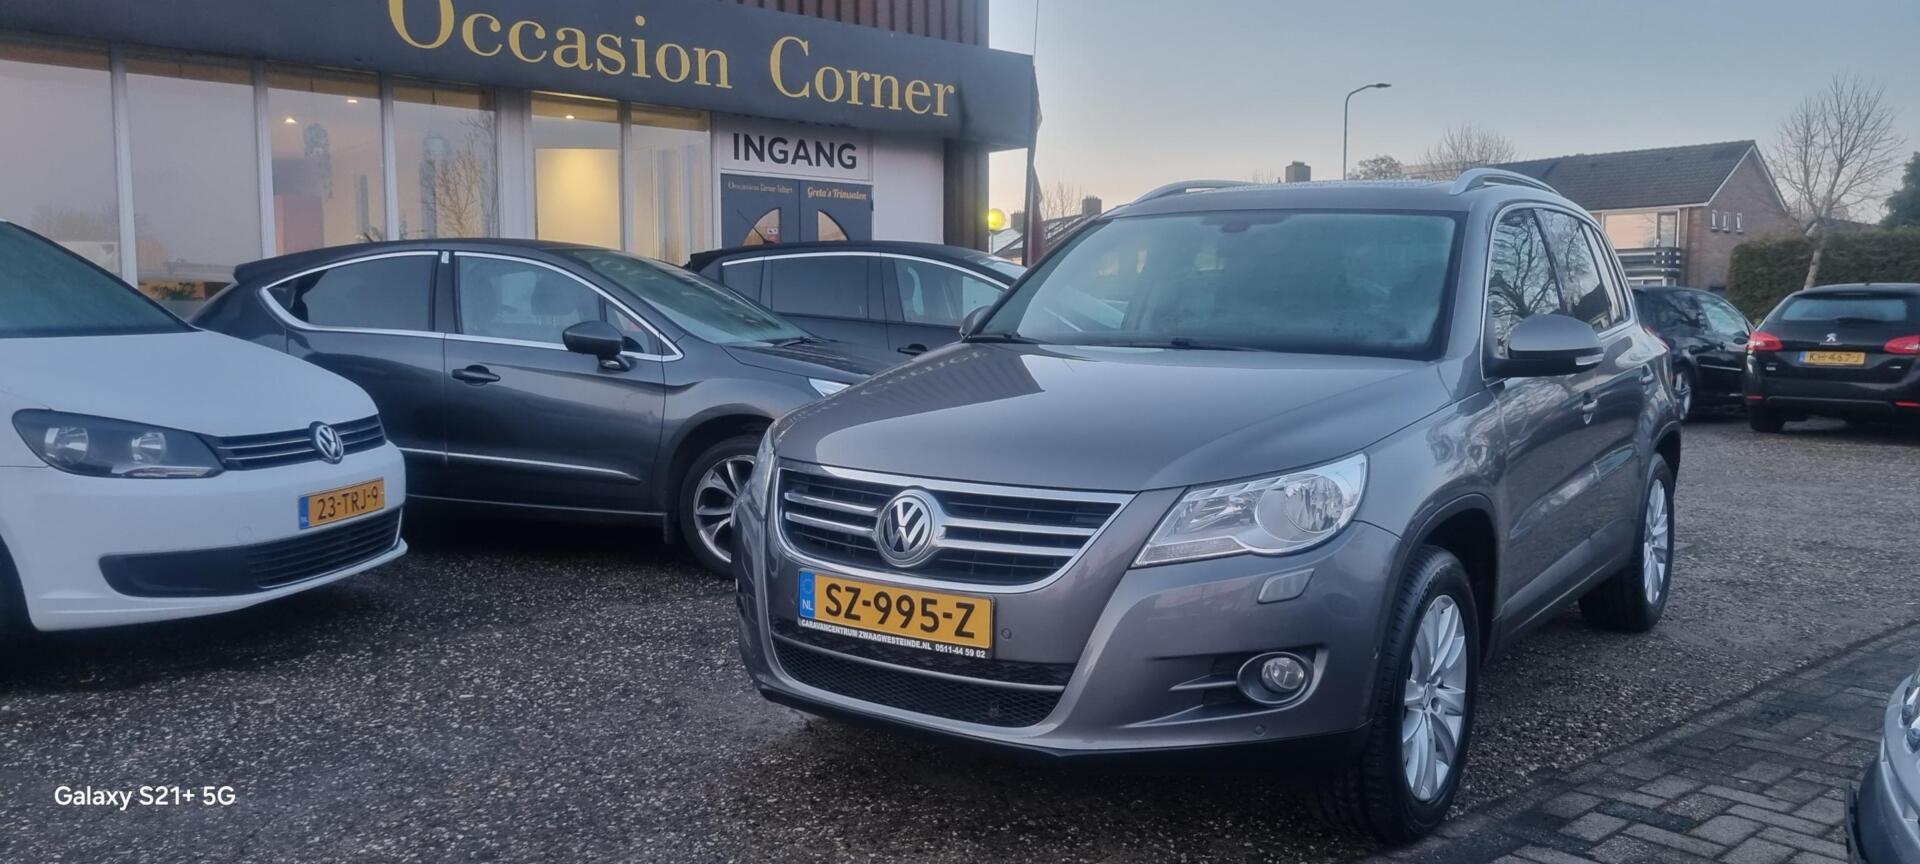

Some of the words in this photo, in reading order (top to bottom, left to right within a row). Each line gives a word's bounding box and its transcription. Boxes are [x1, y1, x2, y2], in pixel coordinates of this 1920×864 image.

[388, 0, 733, 89] Occasion
[769, 36, 955, 117] Corner
[733, 132, 857, 170] INGANG
[317, 485, 379, 521] 23-TRJ-9
[802, 599, 814, 611] NL
[825, 583, 976, 639] SZ-995-Z
[801, 618, 858, 638] CARAVANCENTRUM
[858, 630, 932, 650] ZWAAGWESTEINDE.NL
[975, 649, 986, 659] 02
